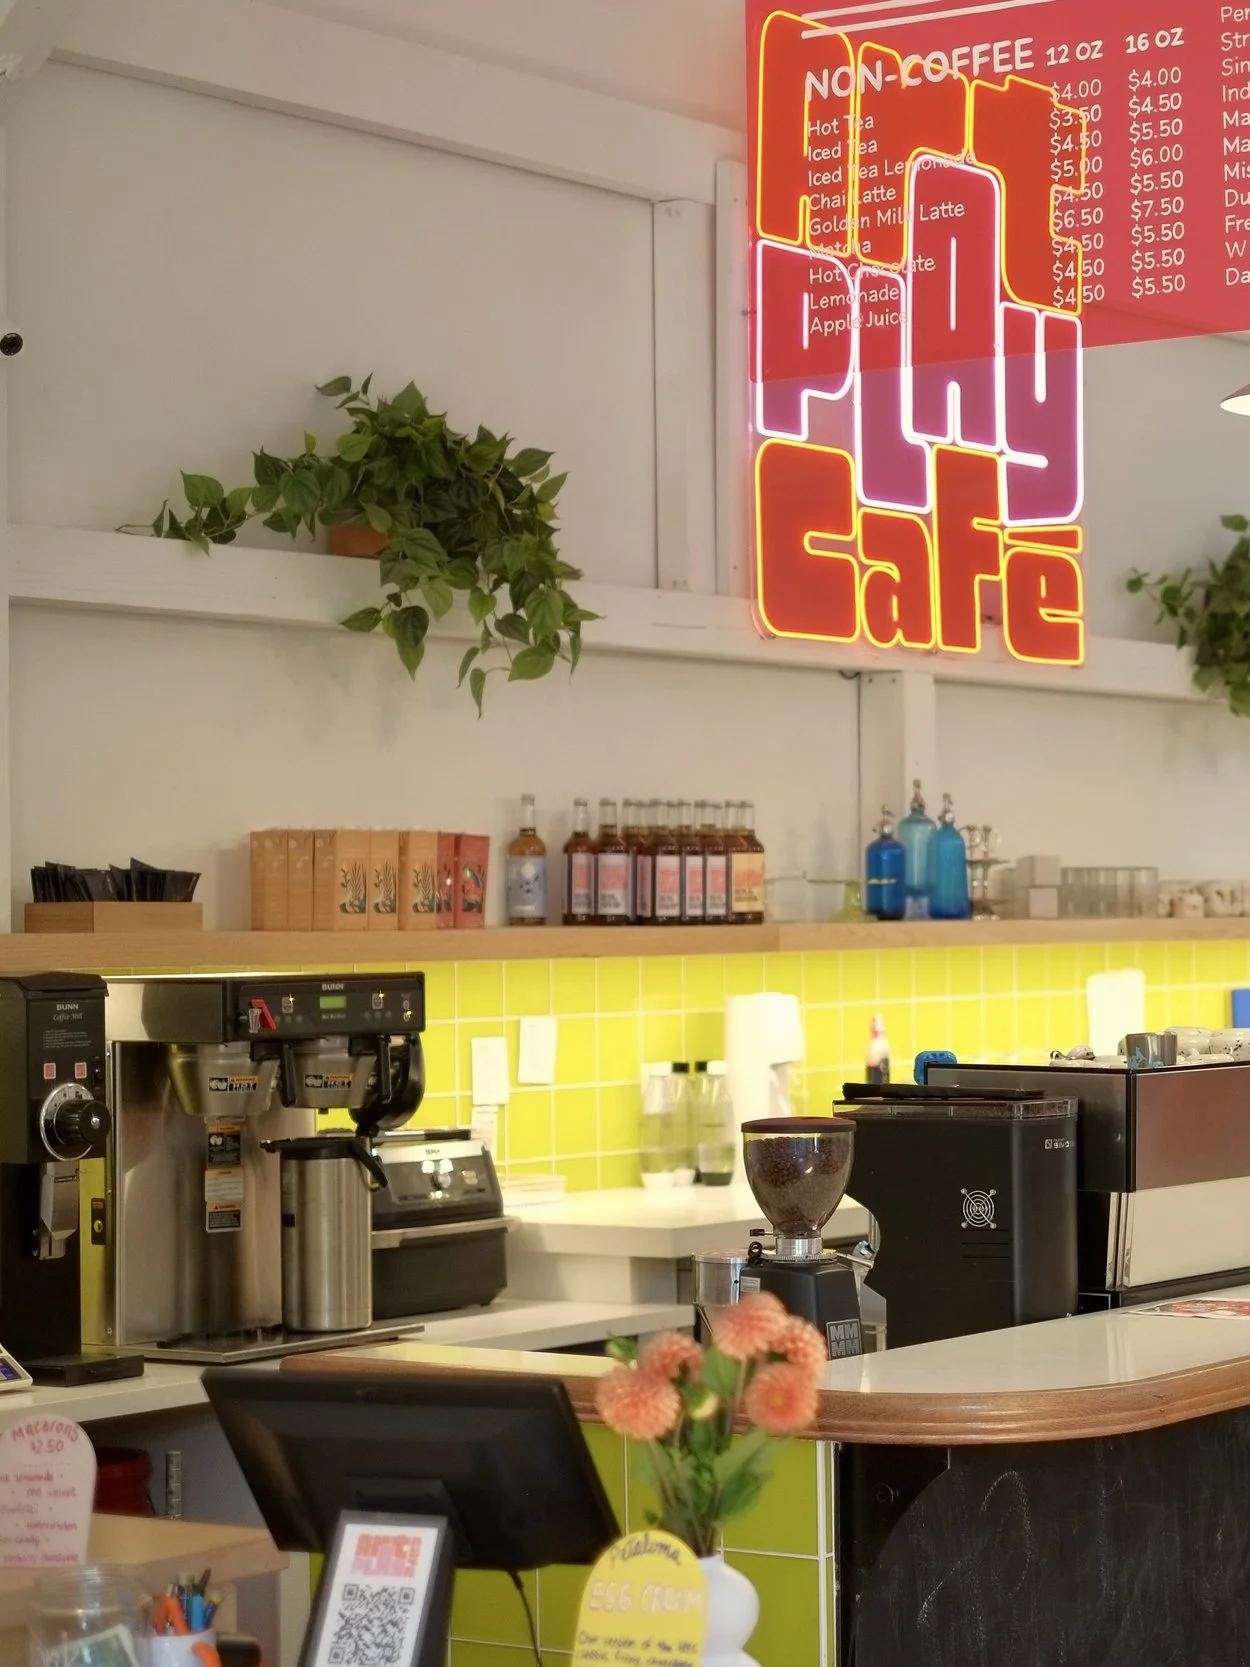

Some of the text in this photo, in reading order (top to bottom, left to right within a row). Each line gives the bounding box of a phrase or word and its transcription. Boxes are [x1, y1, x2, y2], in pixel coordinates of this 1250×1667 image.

[1046, 40, 1103, 66] 12 OZ
[1125, 27, 1184, 54] 16 OZ
[805, 36, 1035, 102] NON-COFFEE
[1128, 66, 1182, 92] $4.00
[1050, 79, 1102, 102] $4.00
[1049, 104, 1102, 130] $3.50
[1128, 93, 1182, 118] $4.50
[808, 114, 874, 137] Hot Tea
[1129, 118, 1183, 144] $5.50
[808, 139, 878, 162] Iced Tea
[1050, 130, 1102, 156] $4.50
[808, 148, 976, 187] Iced Tea Lemonade
[1050, 156, 1103, 182] $5.00
[1130, 144, 1183, 169] $6.00
[1052, 182, 1103, 207] $4.50
[1130, 170, 1184, 196] $5.50
[809, 185, 896, 211] Chai Latte
[1131, 197, 1184, 221] $7.50
[809, 200, 965, 236] Golden Milk Latte
[1052, 207, 1104, 232] $6.50
[1052, 233, 1104, 257] $4.50
[1131, 222, 1185, 247] $5.50
[809, 255, 936, 285] Hot Chocolate
[1131, 248, 1185, 273] $5.50
[810, 285, 899, 310] Lemonade
[1053, 284, 1105, 308] $450
[1131, 274, 1185, 299] $5.50
[809, 308, 908, 336] Apple Juice
[56, 1003, 79, 1011] BUNN
[829, 1323, 859, 1340] MM
[831, 1339, 860, 1357] MM
